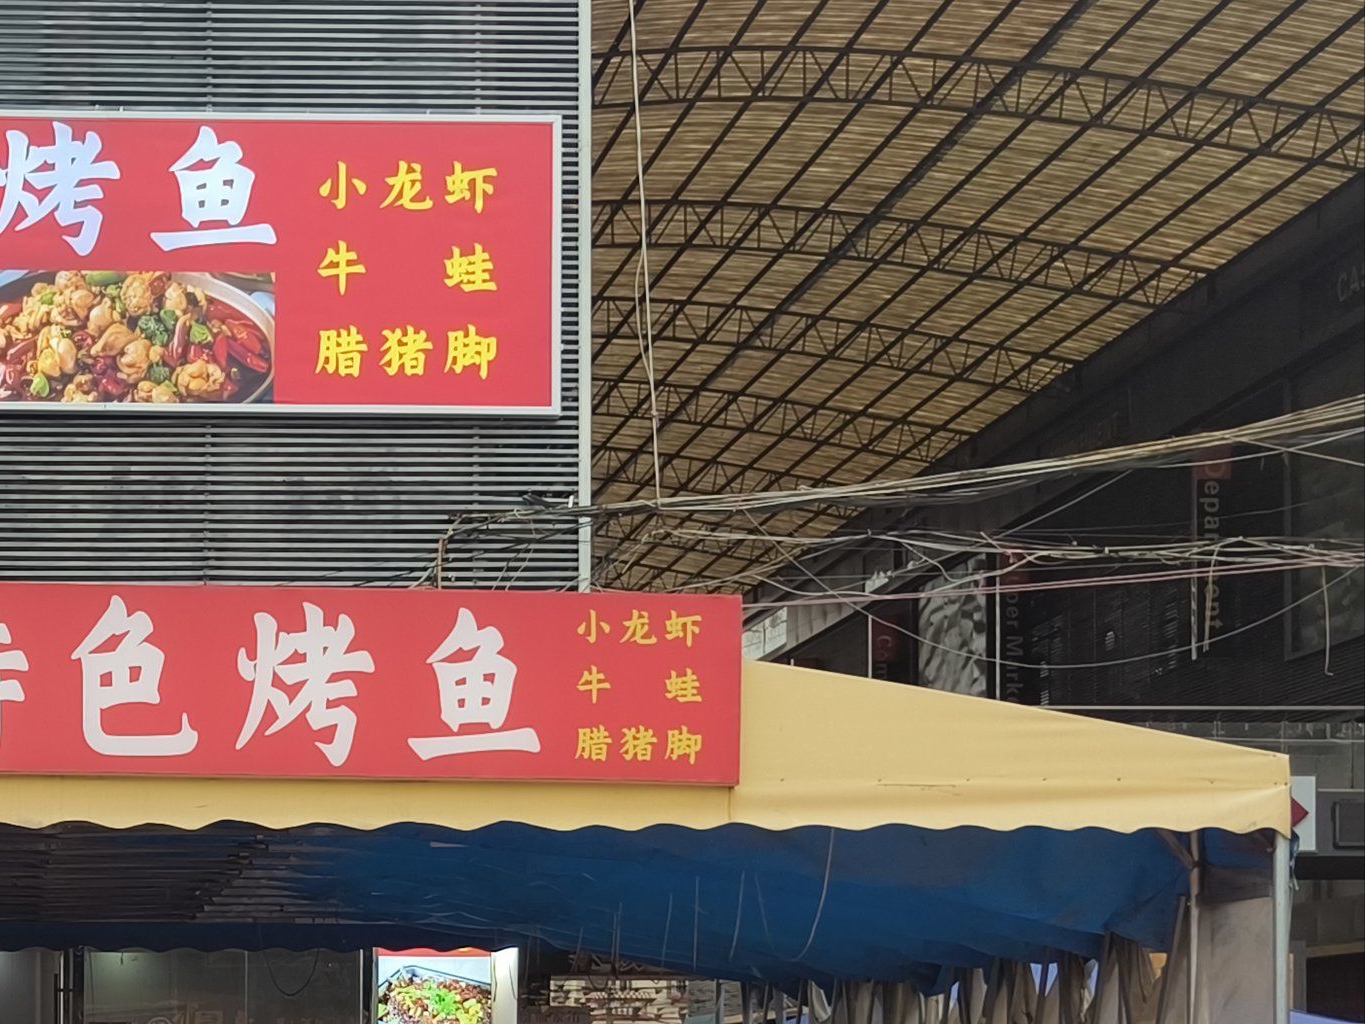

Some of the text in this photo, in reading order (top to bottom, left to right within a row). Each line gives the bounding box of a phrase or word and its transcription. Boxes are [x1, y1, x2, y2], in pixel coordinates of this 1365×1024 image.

[318, 159, 498, 214] 小龙虾
[316, 239, 498, 296] 牛蛙
[314, 323, 498, 380] 腊猪脚
[576, 609, 703, 648] 小龙虾
[575, 665, 703, 704] 牛蛙
[574, 724, 703, 765] 腊猪脚
